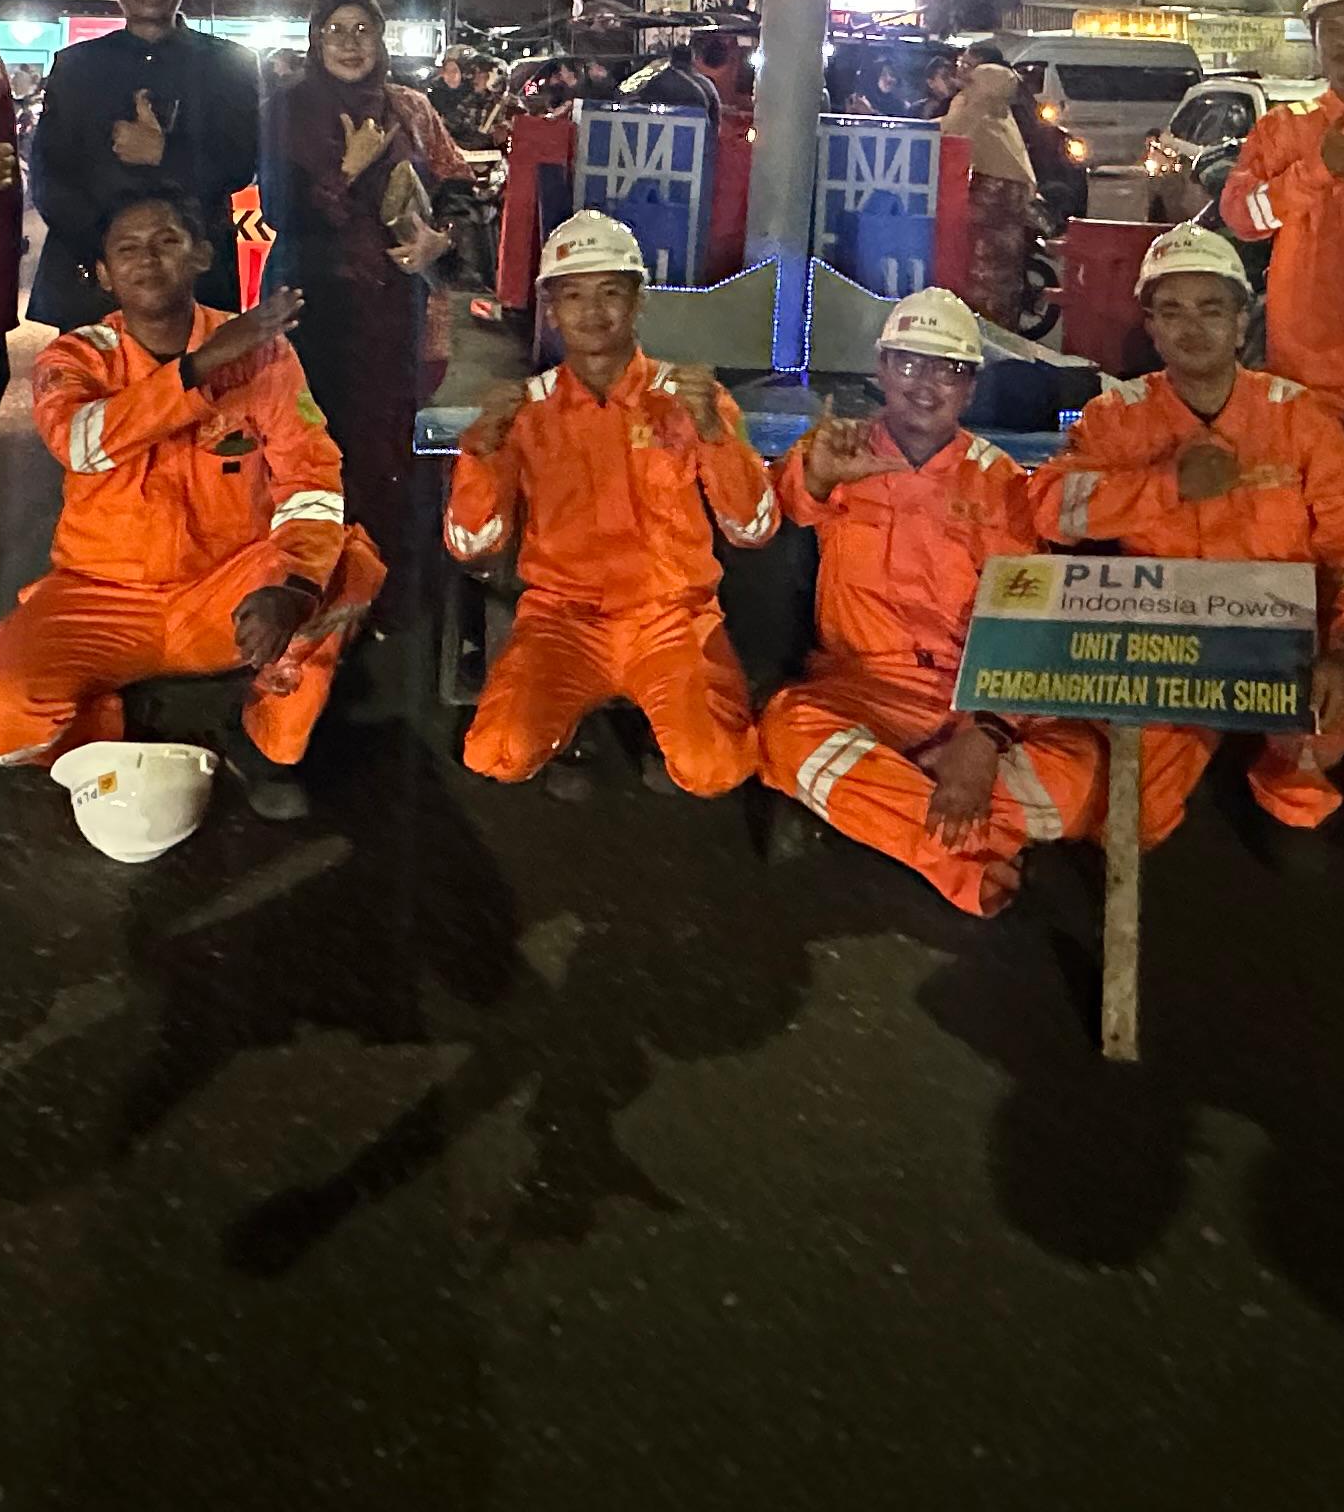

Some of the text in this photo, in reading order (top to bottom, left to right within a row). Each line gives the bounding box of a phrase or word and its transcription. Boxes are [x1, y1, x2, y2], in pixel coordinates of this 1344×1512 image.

[911, 316, 937, 326] PLN
[1063, 563, 1164, 589] PLN
[1060, 592, 1299, 619] Indonesia Power
[1070, 631, 1201, 666] UNIT BISNIS
[974, 669, 1298, 716] PEMBANGKITAN TELUK SIRIH
